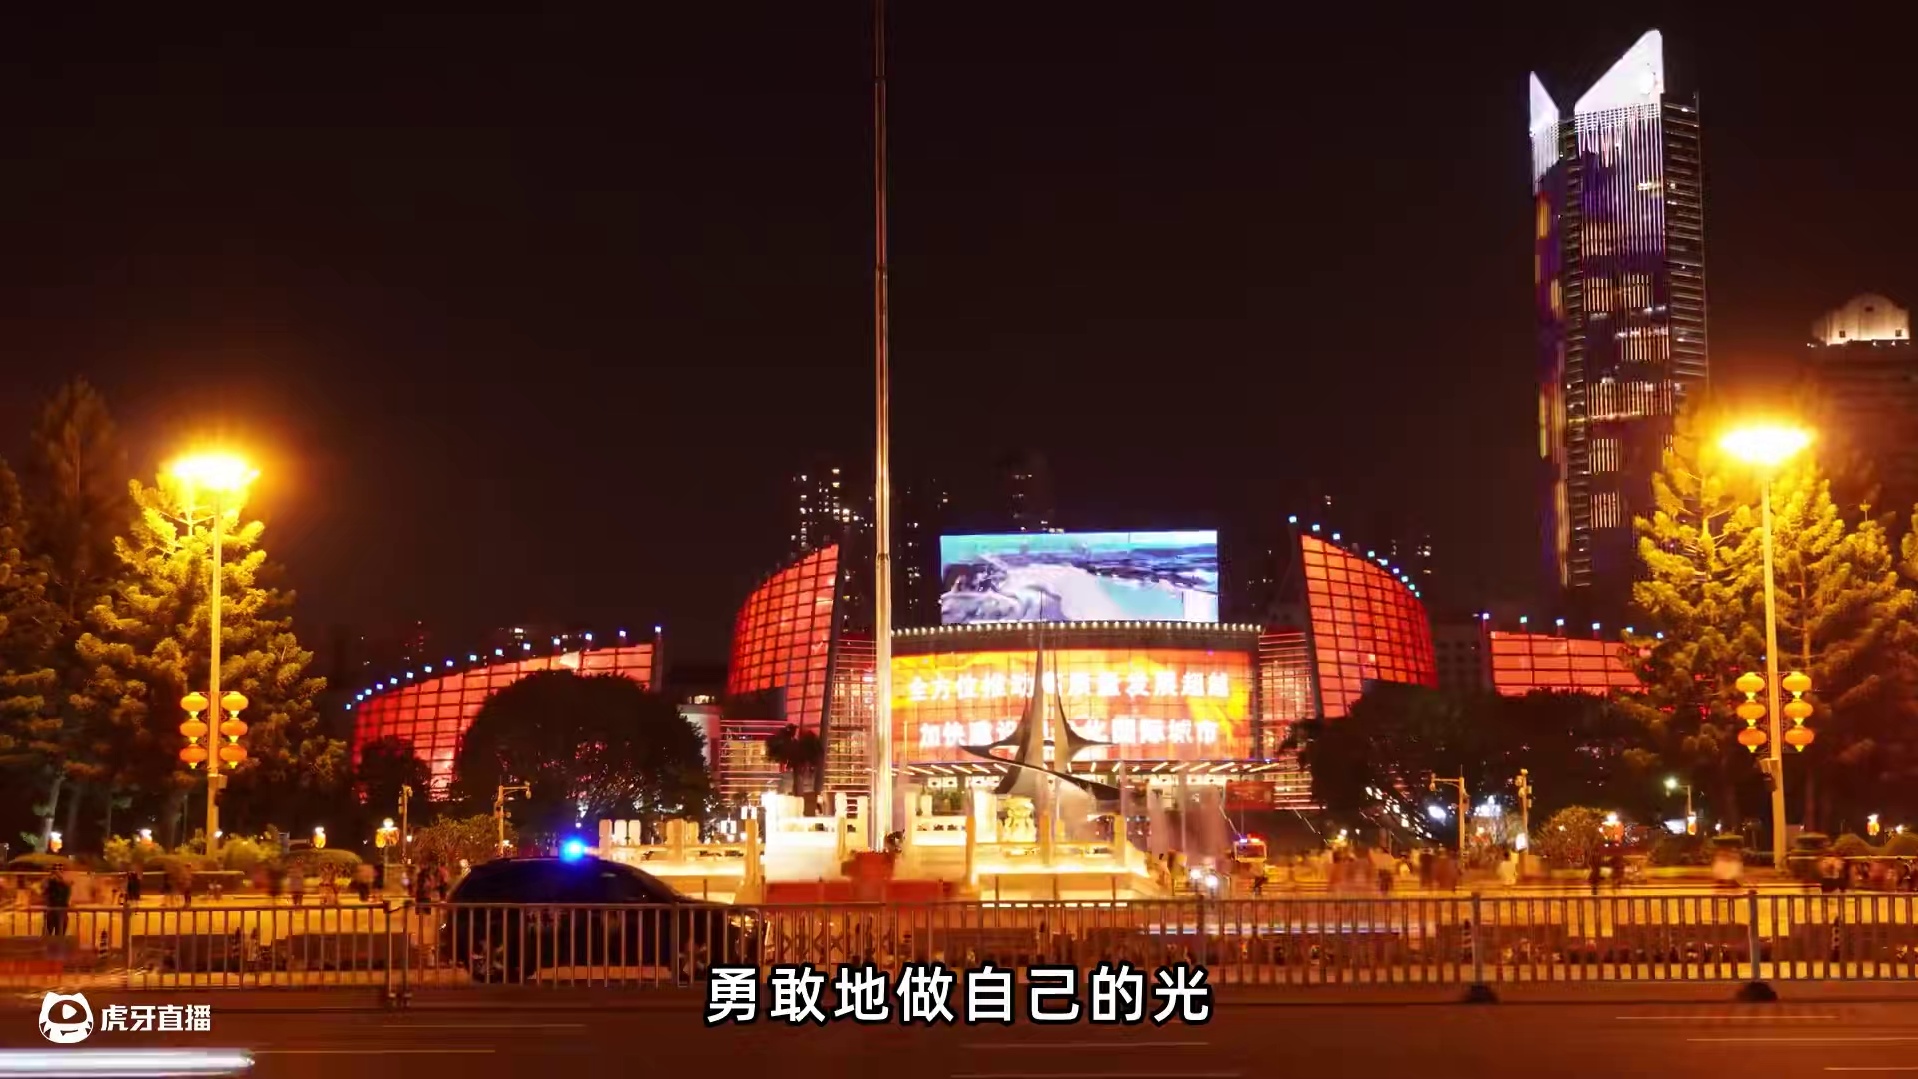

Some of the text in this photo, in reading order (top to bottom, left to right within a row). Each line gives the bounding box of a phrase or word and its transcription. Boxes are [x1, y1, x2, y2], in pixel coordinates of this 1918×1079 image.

[919, 718, 1219, 748] 加快建设化国际城市
